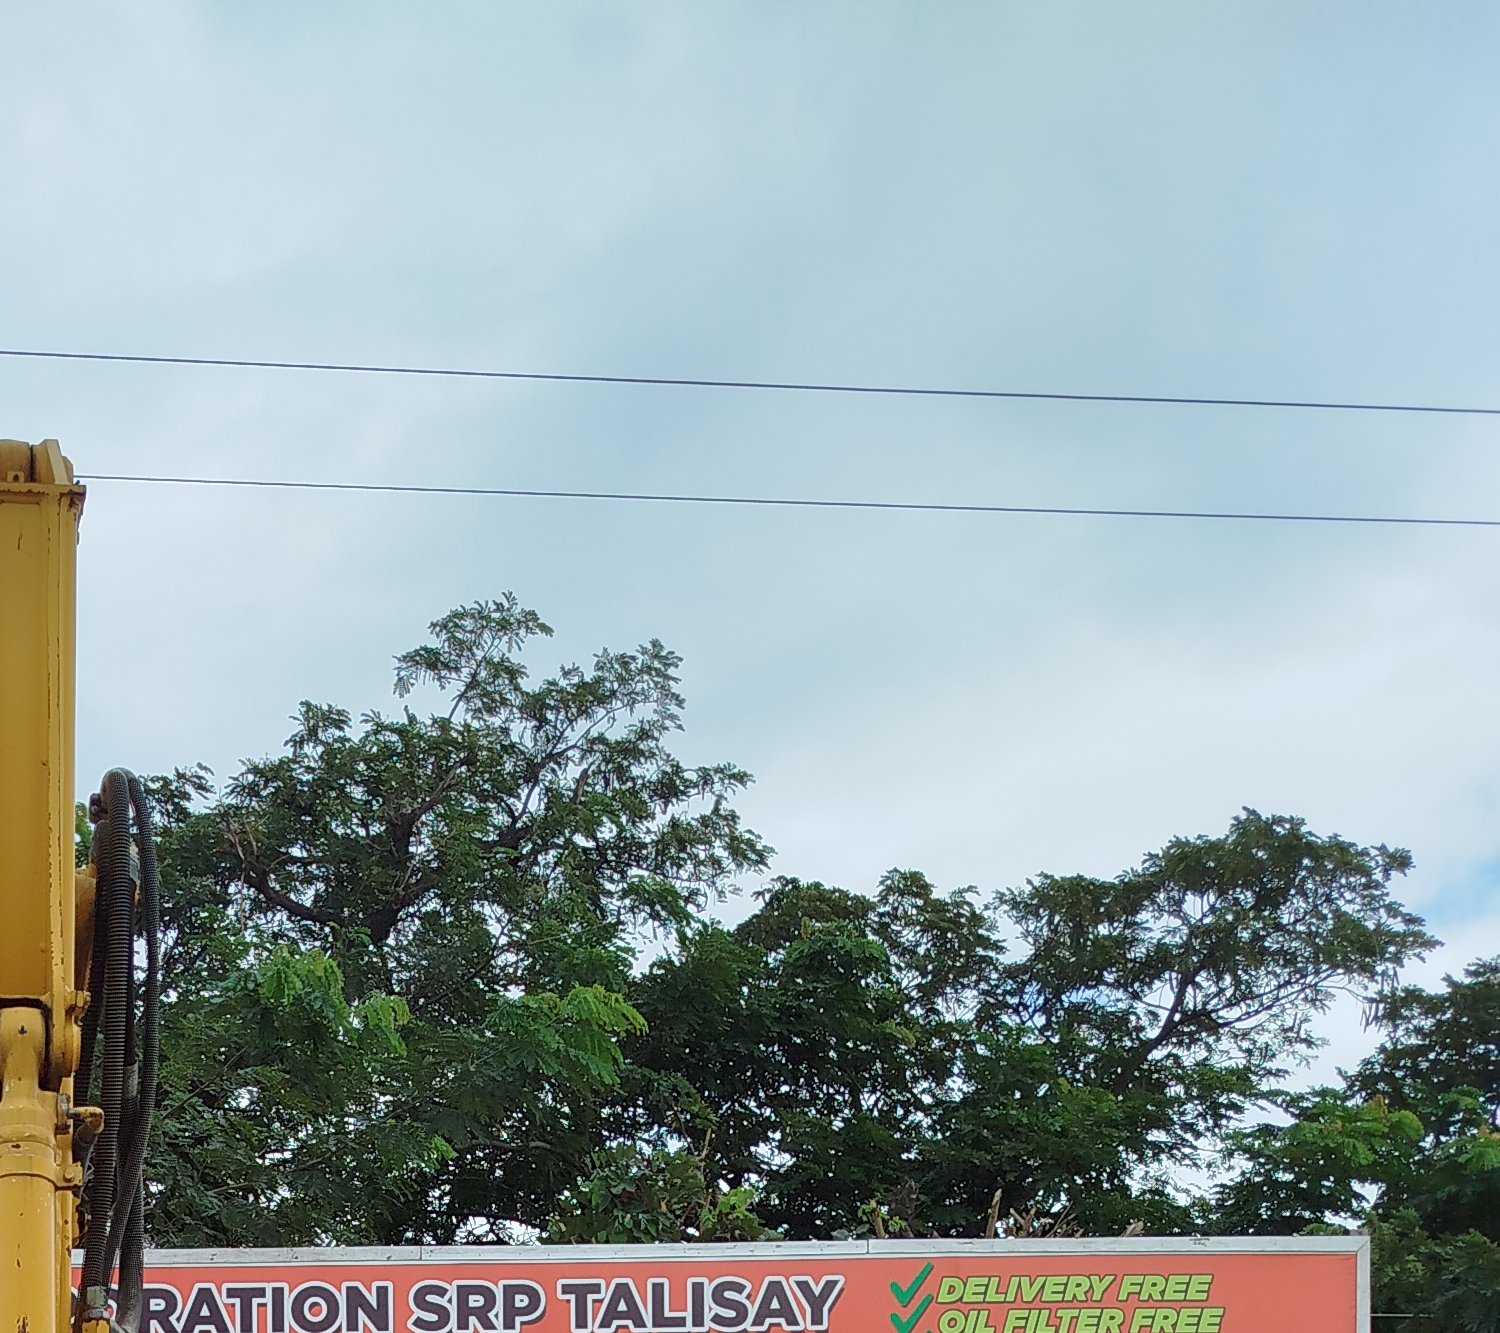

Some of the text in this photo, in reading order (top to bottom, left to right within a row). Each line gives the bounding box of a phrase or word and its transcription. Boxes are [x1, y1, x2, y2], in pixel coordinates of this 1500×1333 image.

[557, 1275, 845, 1333] TALISAY
[936, 1274, 1213, 1304] DELIVERY FREE
